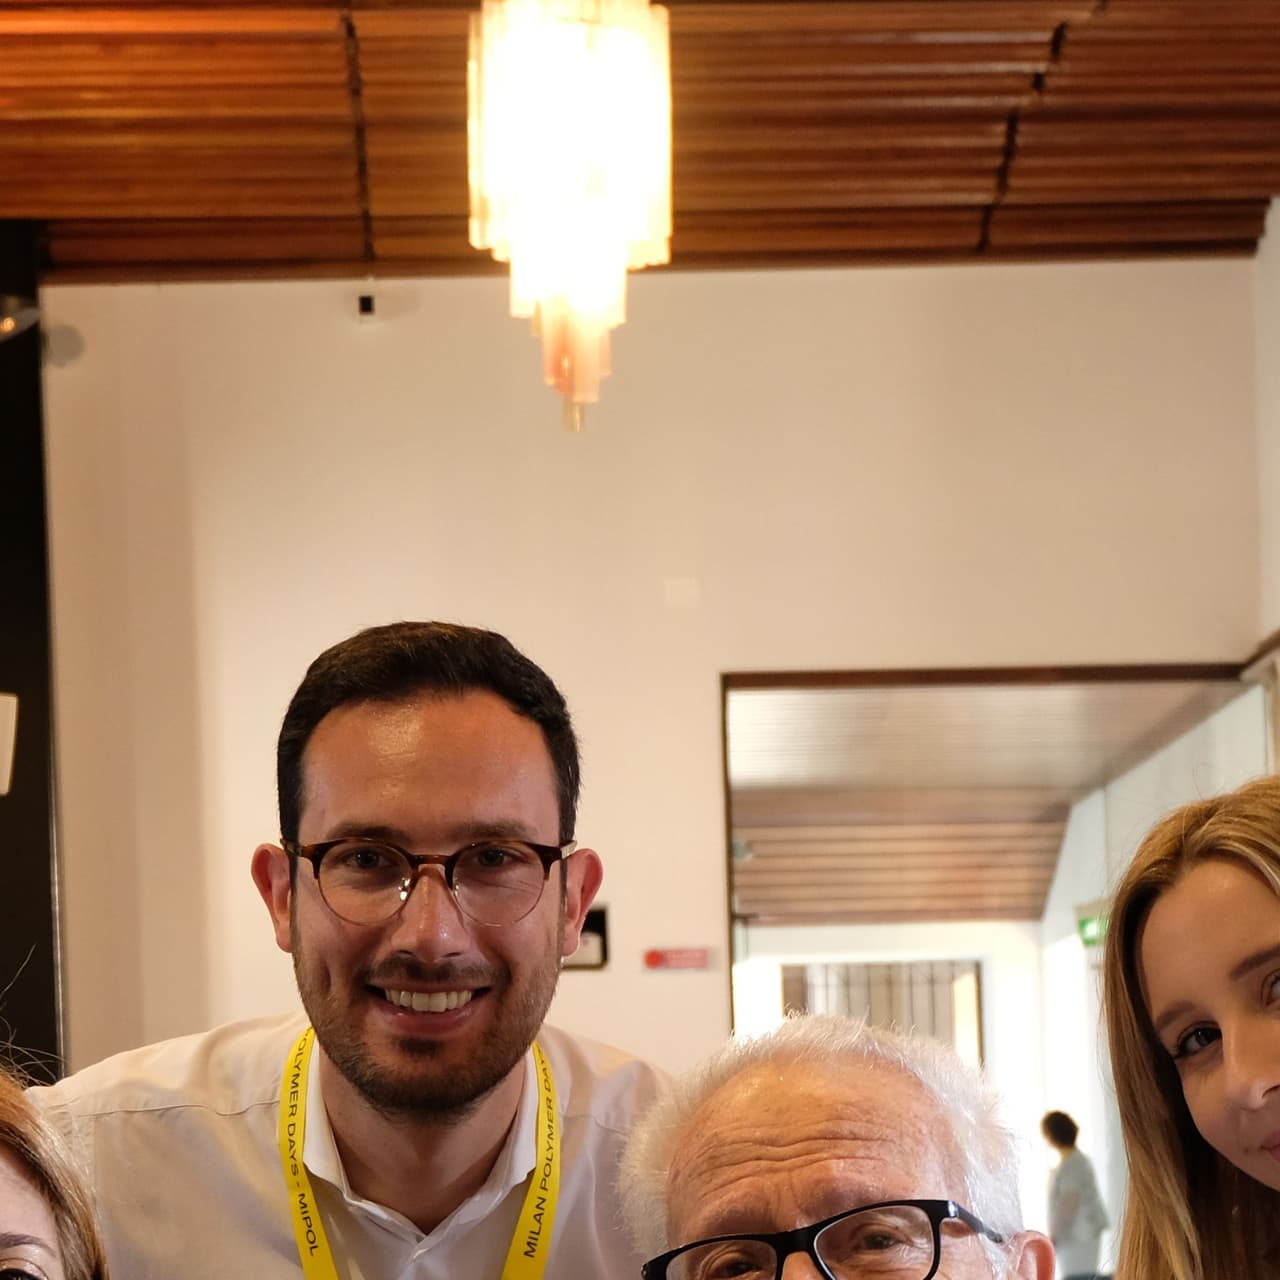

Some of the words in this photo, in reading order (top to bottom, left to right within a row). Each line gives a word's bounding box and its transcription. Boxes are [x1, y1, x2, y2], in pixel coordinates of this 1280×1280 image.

[287, 1123, 299, 1176] DAYS
[298, 1193, 319, 1256] MIPOL
[523, 1196, 547, 1258] MILAN
[539, 1097, 554, 1192] POLYMER
